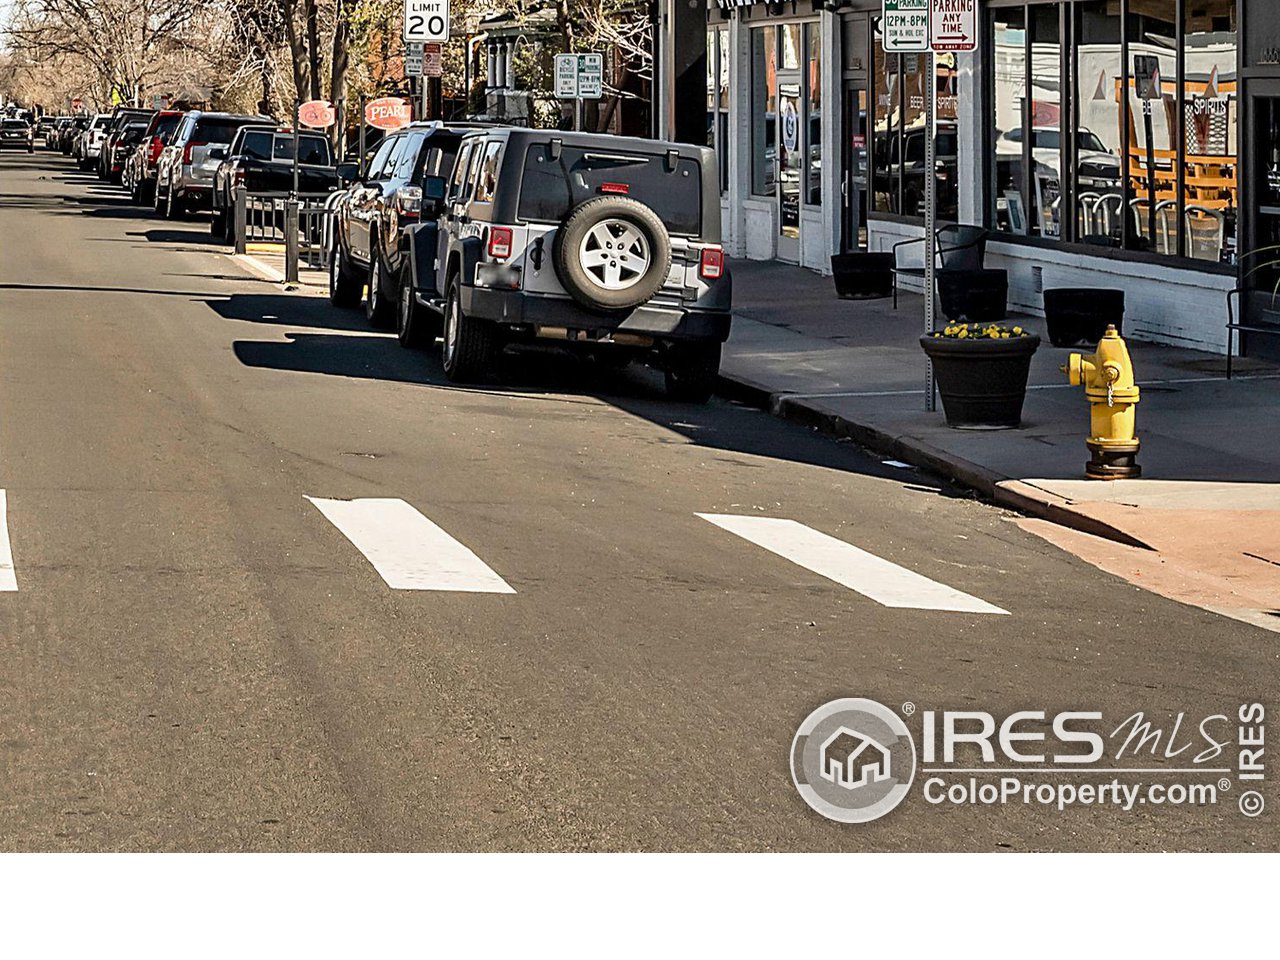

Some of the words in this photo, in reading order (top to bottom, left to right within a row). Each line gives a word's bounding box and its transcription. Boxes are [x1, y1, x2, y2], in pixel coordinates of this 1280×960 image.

[412, 3, 441, 12] LIMIT
[933, 0, 973, 12] PARKING
[886, 15, 927, 27] 12PM-8PM
[942, 13, 961, 22] ANY
[408, 15, 445, 35] 20
[941, 23, 963, 33] TIME
[1193, 99, 1227, 115] SPIRITS
